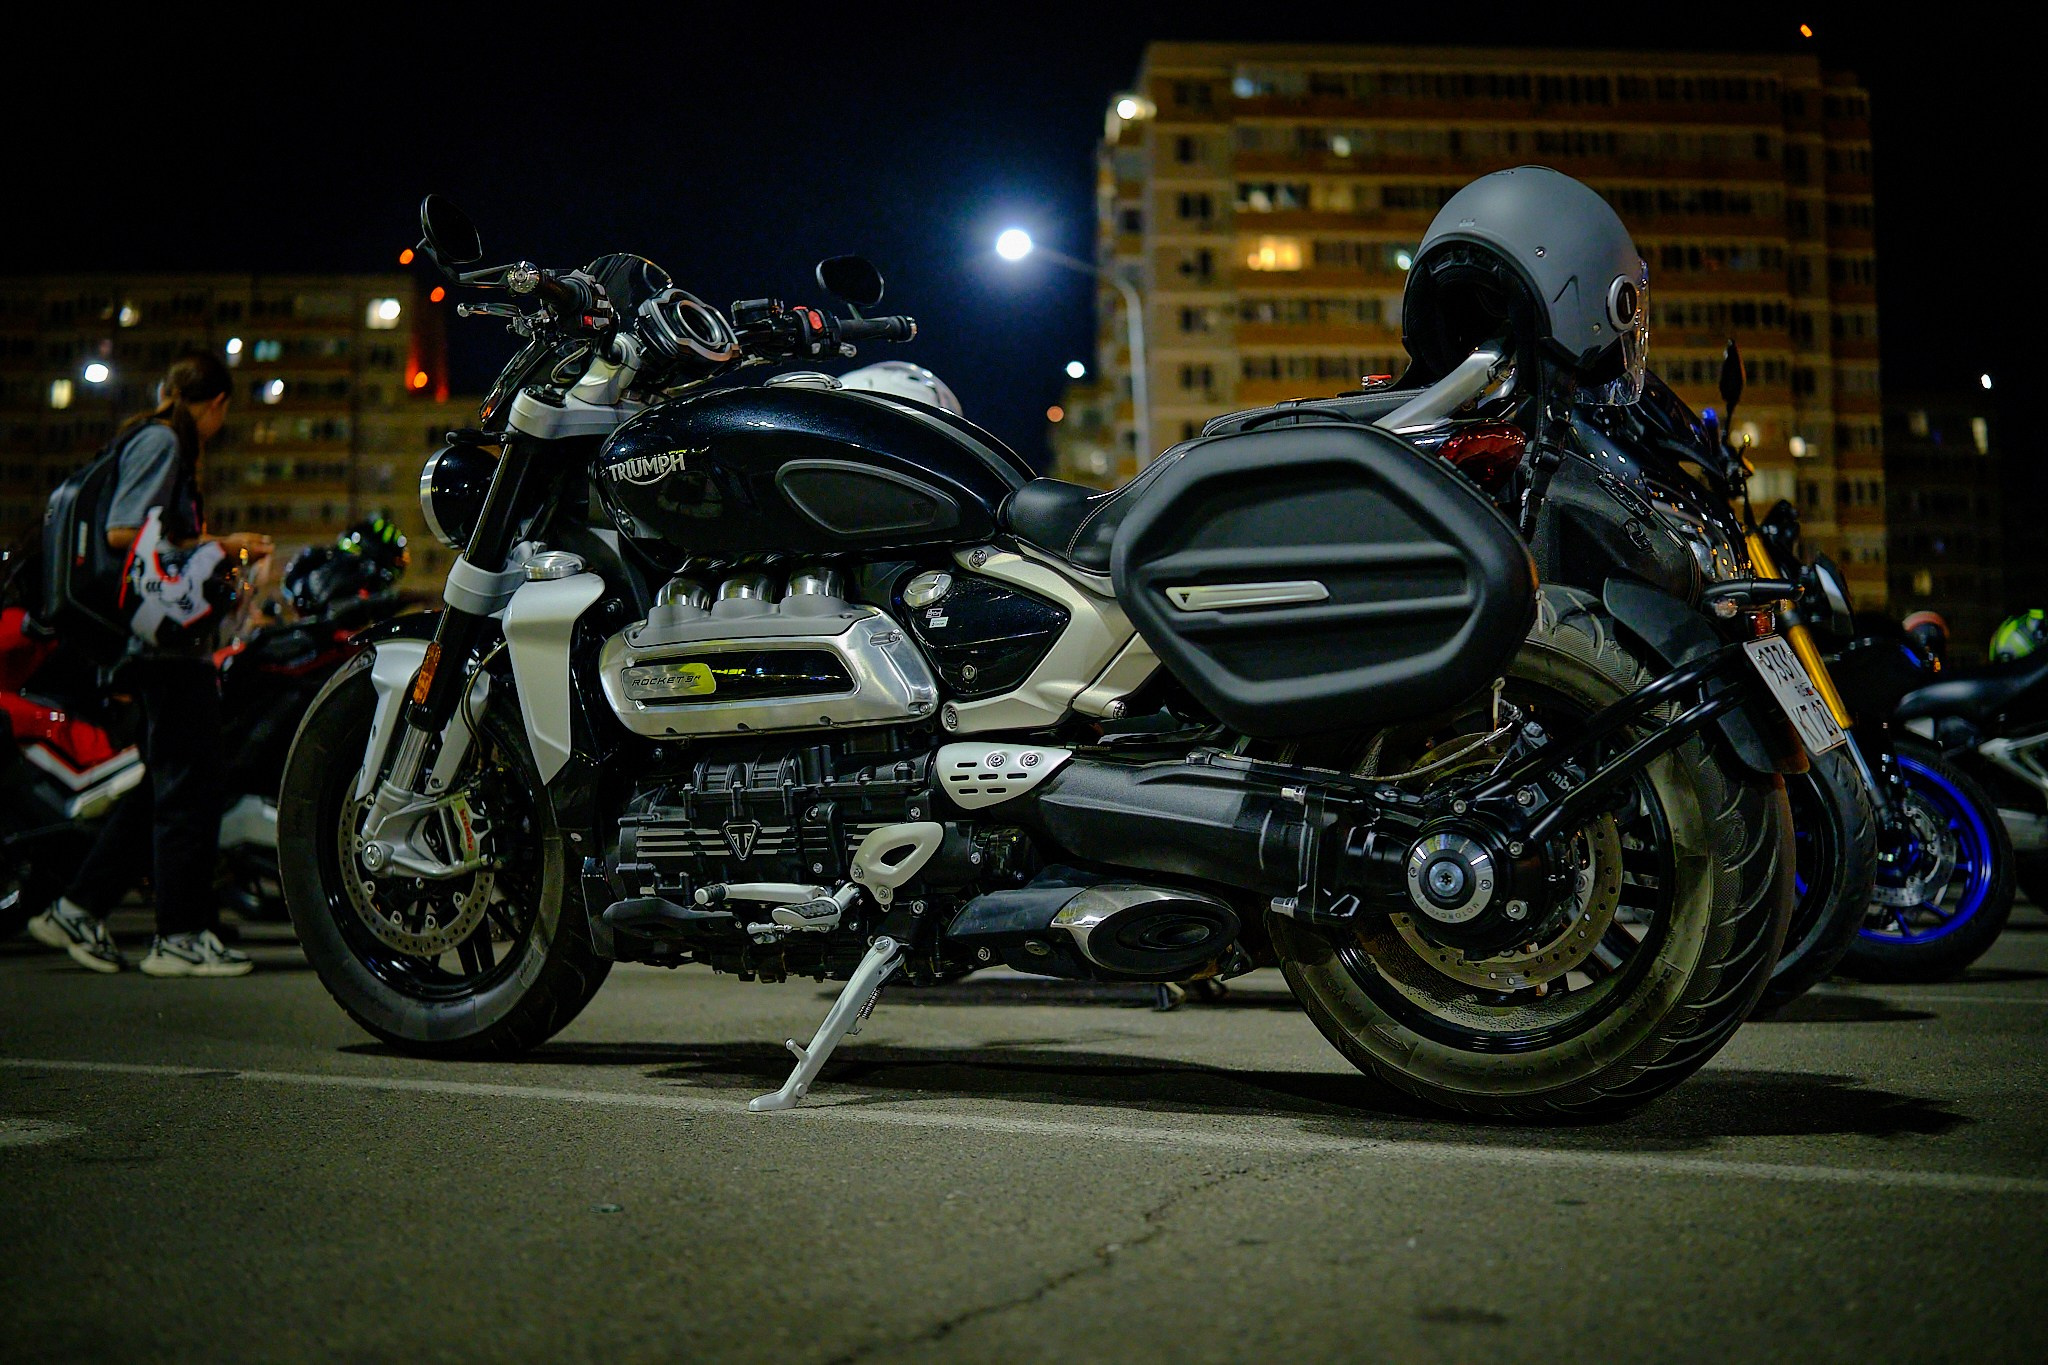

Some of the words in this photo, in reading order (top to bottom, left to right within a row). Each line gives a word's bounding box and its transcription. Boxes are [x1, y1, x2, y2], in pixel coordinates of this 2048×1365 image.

[608, 453, 686, 486] TRIUMPH
[631, 675, 685, 687] ROCKET
[1810, 699, 1839, 737] 23
